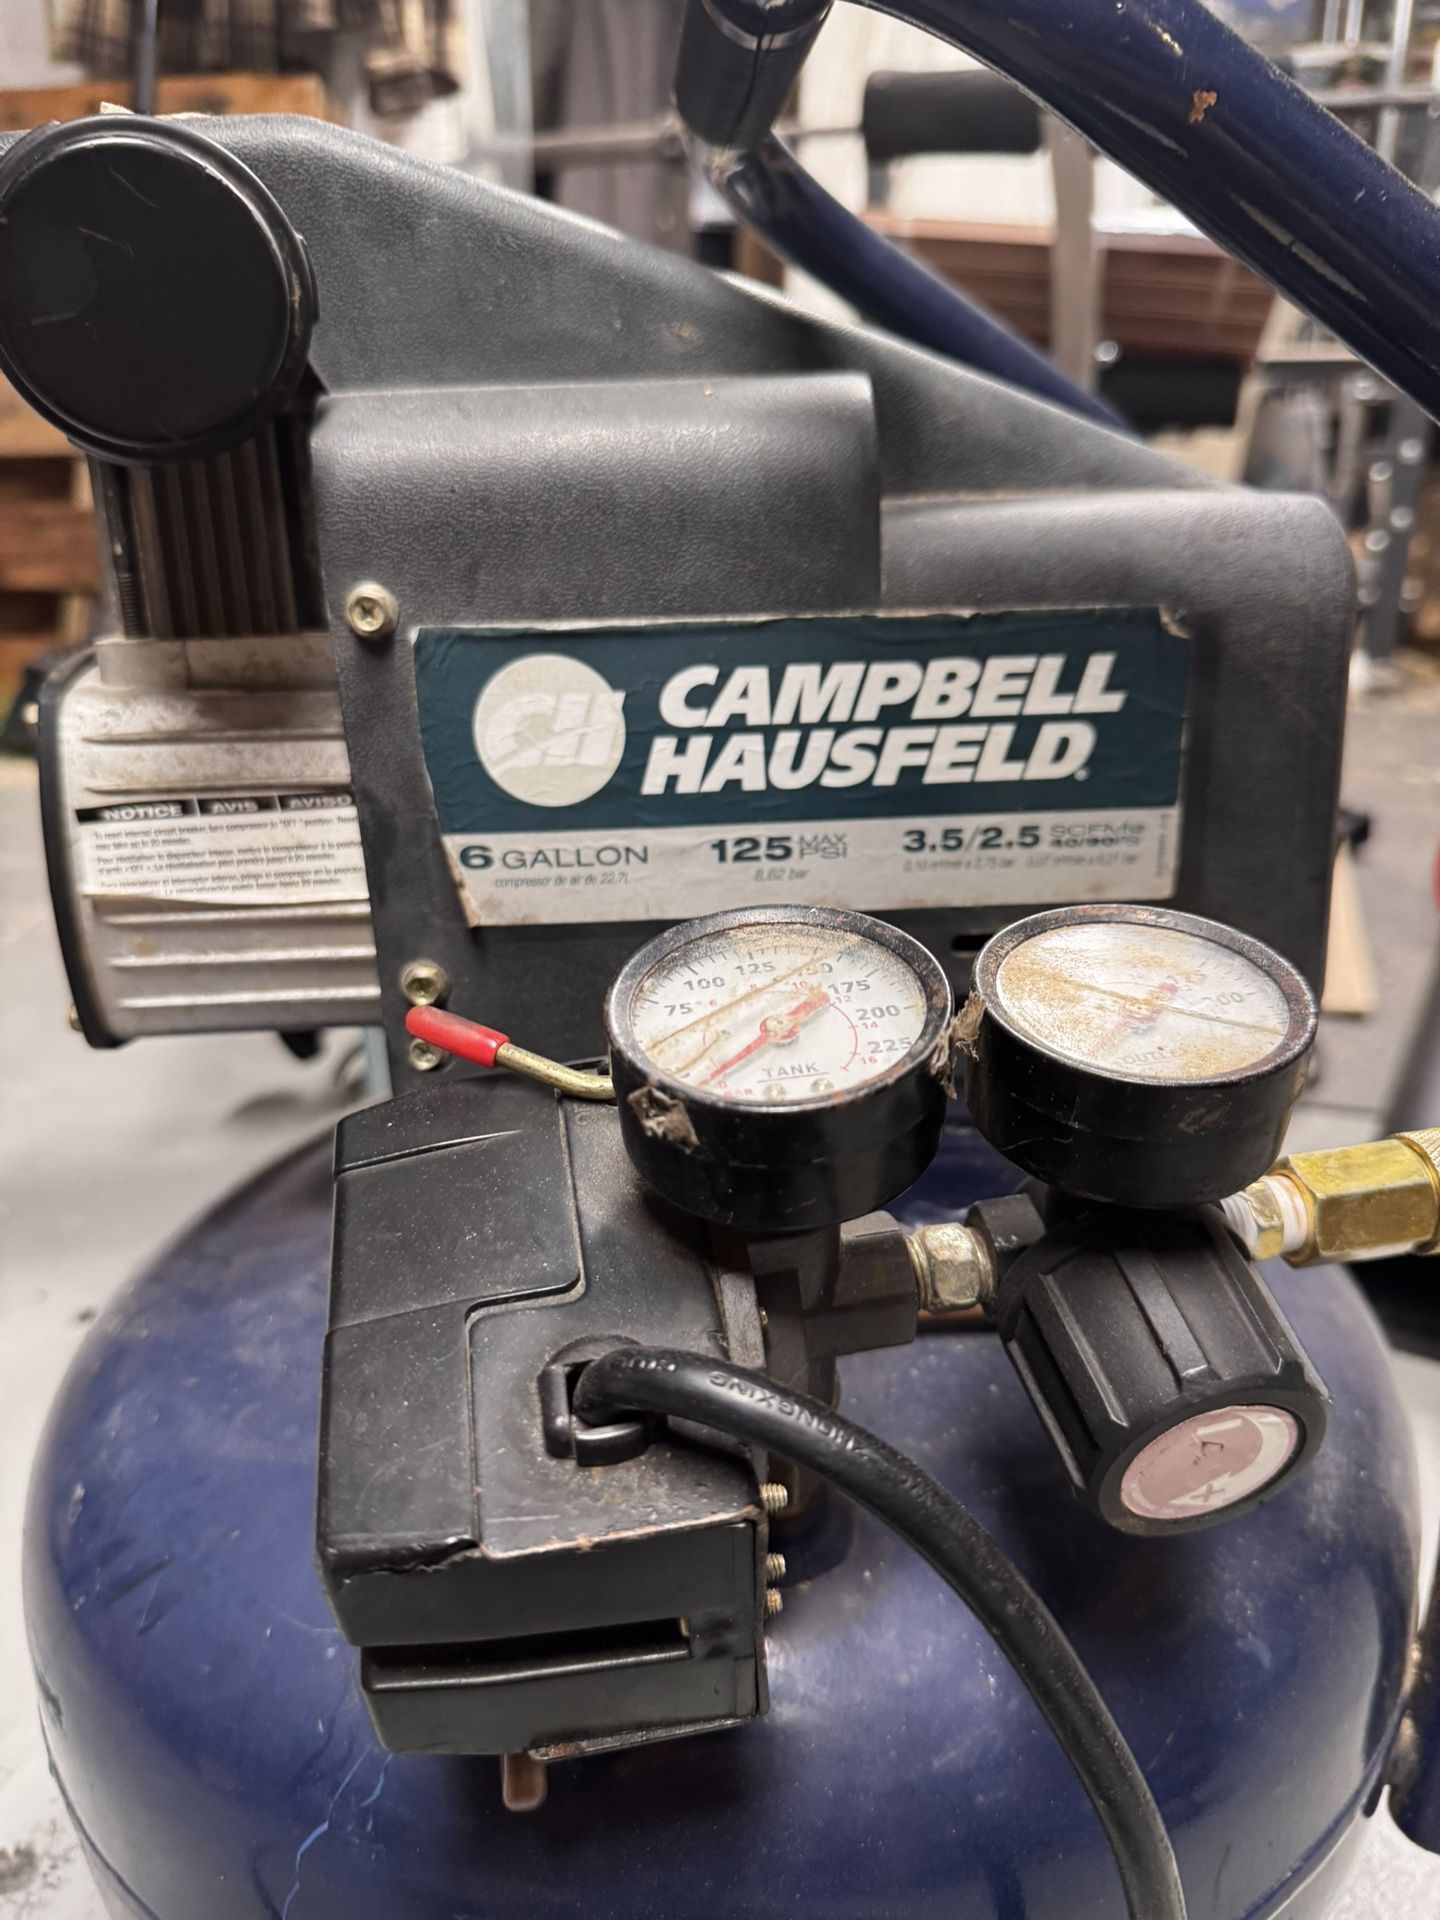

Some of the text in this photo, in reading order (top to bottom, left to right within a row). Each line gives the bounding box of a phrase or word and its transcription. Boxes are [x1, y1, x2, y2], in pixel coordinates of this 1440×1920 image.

[659, 652, 1128, 728] CAMPBELL
[641, 721, 1096, 796] HAUSFELD
[211, 799, 259, 815] AVIS
[289, 795, 352, 810] AVISO
[103, 802, 183, 820] NOTICE
[902, 825, 1041, 852] 3.5/2.5
[459, 844, 649, 870] 6 GALLON
[710, 836, 793, 864] 125
[799, 844, 847, 860] PSI
[735, 961, 777, 976] 125
[683, 975, 726, 991] 100
[828, 979, 871, 995] 175
[835, 994, 853, 1004] 12
[663, 1002, 694, 1017] 75
[855, 1004, 901, 1021] 200
[861, 1021, 879, 1030] 14
[867, 1036, 912, 1054] 225
[860, 1055, 878, 1065] 16
[762, 1062, 819, 1079] TANK
